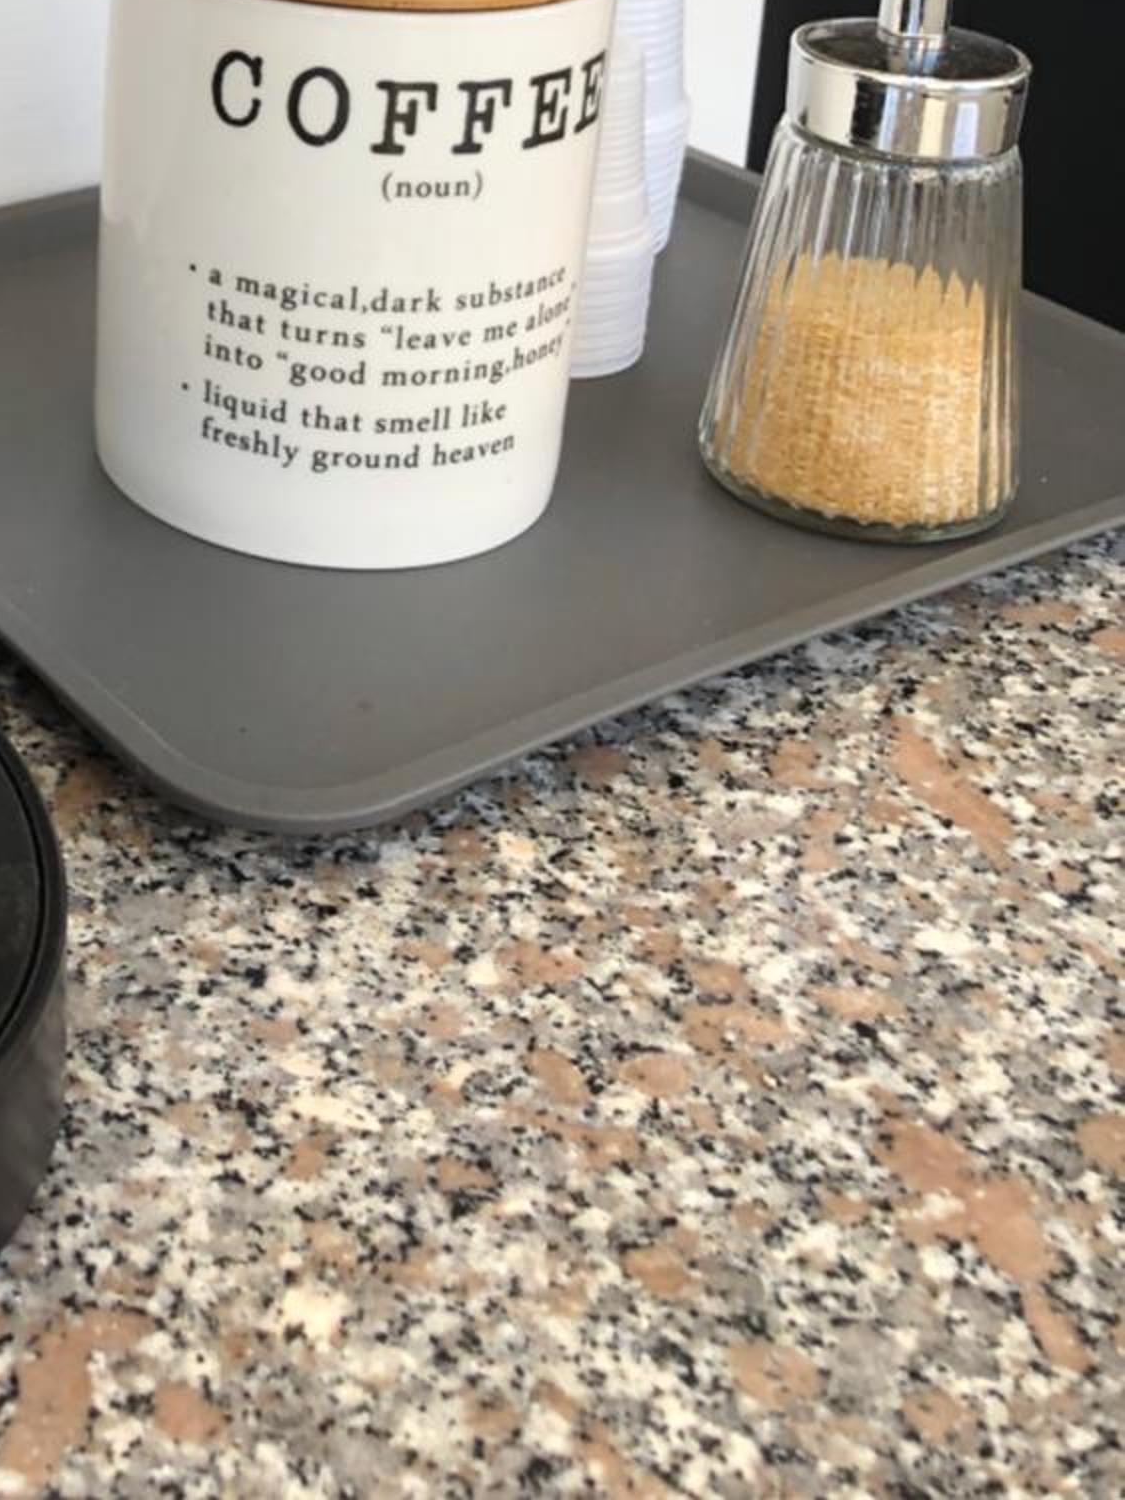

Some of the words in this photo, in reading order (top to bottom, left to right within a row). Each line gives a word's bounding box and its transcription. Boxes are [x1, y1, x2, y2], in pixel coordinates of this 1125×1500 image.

[211, 49, 606, 155] COFFEE
[381, 171, 484, 202] (noun)
[208, 267, 222, 286] a
[455, 264, 567, 311] substance
[206, 299, 267, 336] that
[280, 319, 367, 349] turns
[483, 322, 518, 343] me
[203, 334, 264, 371] into
[202, 379, 288, 423] liquid
[301, 407, 363, 433] that
[374, 405, 452, 434] smell
[461, 400, 508, 426] like
[200, 417, 299, 469] freshly
[311, 443, 421, 474] ground
[431, 433, 516, 467] heaven
